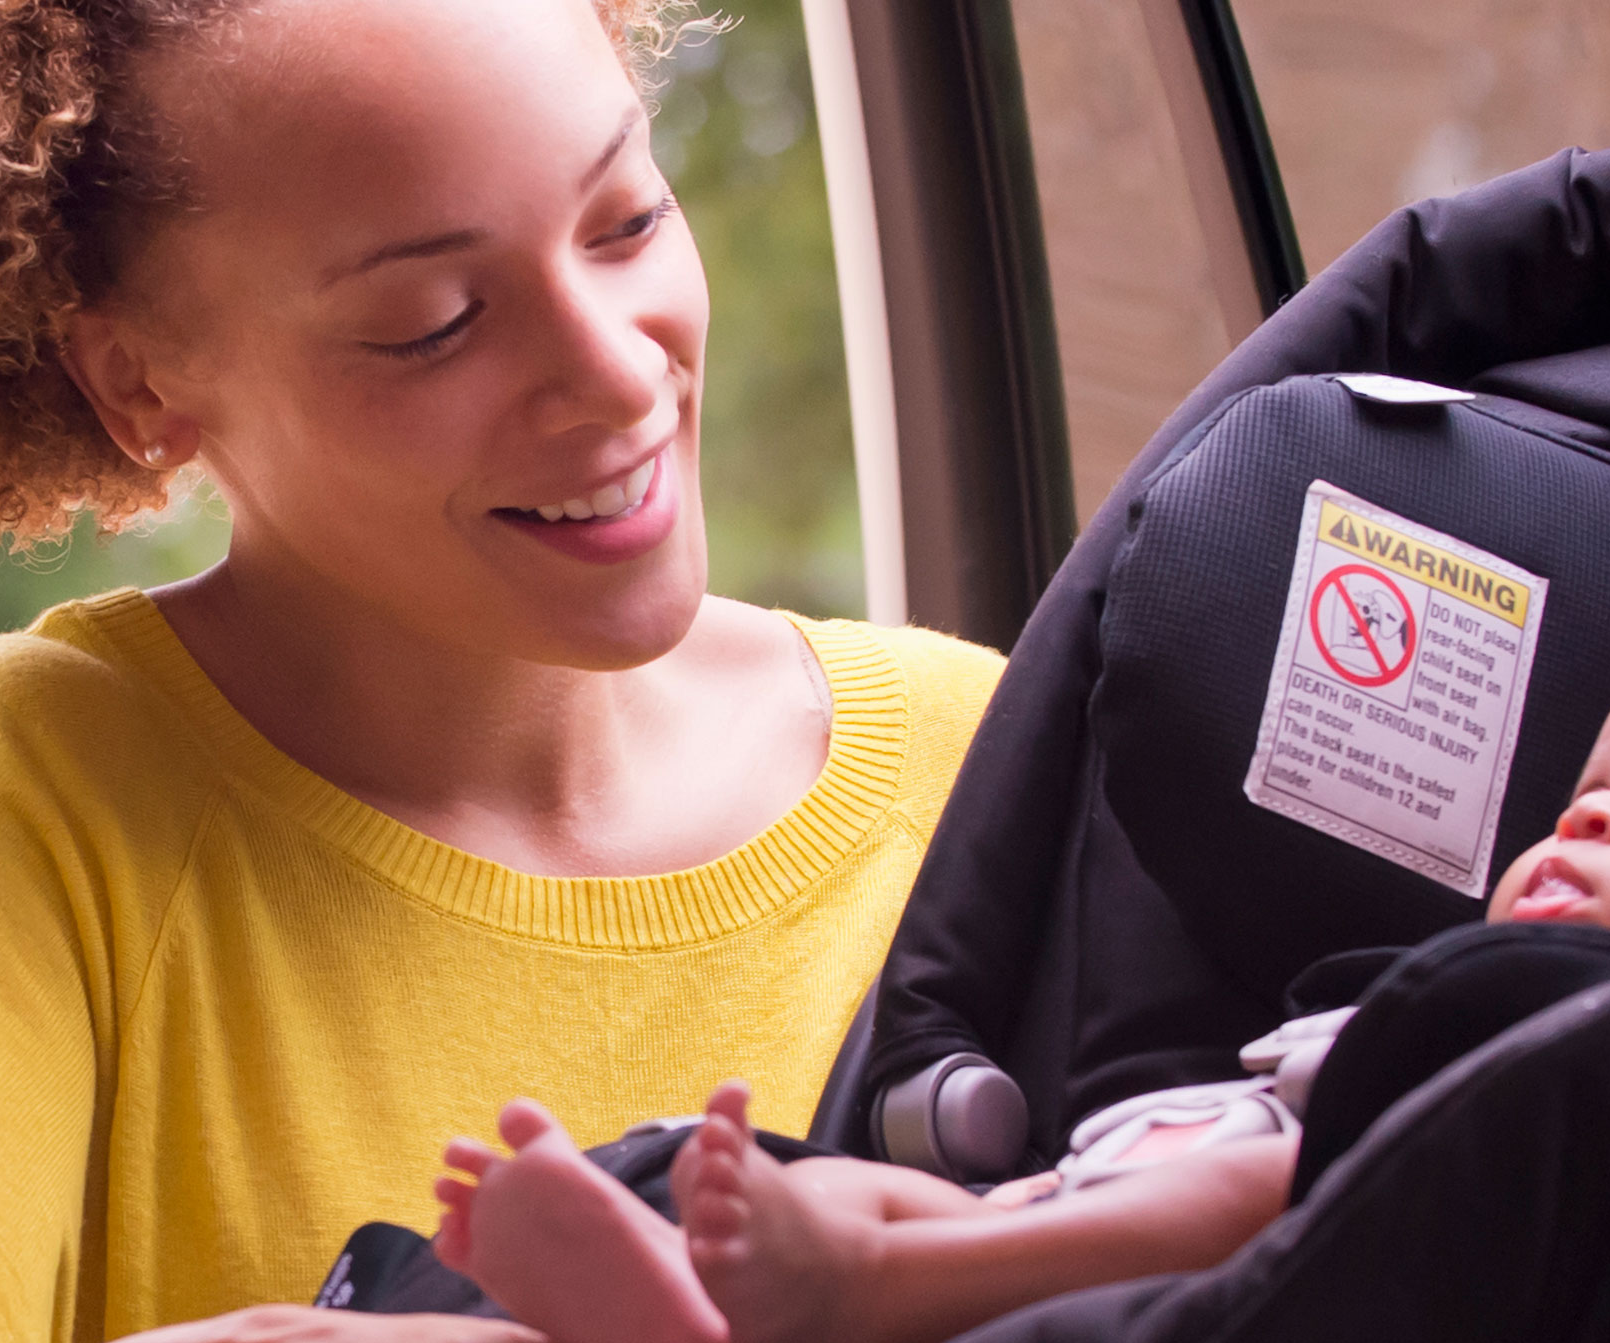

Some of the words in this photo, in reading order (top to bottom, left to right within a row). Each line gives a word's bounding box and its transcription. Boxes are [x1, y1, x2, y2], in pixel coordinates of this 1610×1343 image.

[1363, 525, 1515, 613] WARNING
[1426, 628, 1495, 672] rear-facing
[1430, 602, 1450, 623] DO
[1454, 613, 1481, 637] NOT
[1483, 630, 1516, 655] place
[1416, 670, 1447, 696] front
[1449, 688, 1477, 710] seat
[1422, 650, 1453, 674] child
[1456, 666, 1484, 688] seat
[1486, 681, 1502, 697] on
[1287, 698, 1312, 717] can
[1292, 673, 1339, 704] DEATH
[1342, 693, 1363, 714] OR
[1365, 703, 1427, 742] SERIOUS
[1429, 731, 1479, 765] INJURY
[1412, 695, 1440, 718] with
[1442, 710, 1461, 727] air
[1275, 741, 1314, 767] place
[1317, 754, 1337, 776] for
[1339, 766, 1394, 800] children
[1398, 789, 1414, 809] 12
[1415, 800, 1441, 821] and
[1284, 714, 1308, 739] The
[1311, 727, 1342, 754] back
[1346, 746, 1376, 768] seat
[1377, 756, 1390, 775] is
[1392, 763, 1414, 785] the
[1416, 776, 1457, 803] safest
